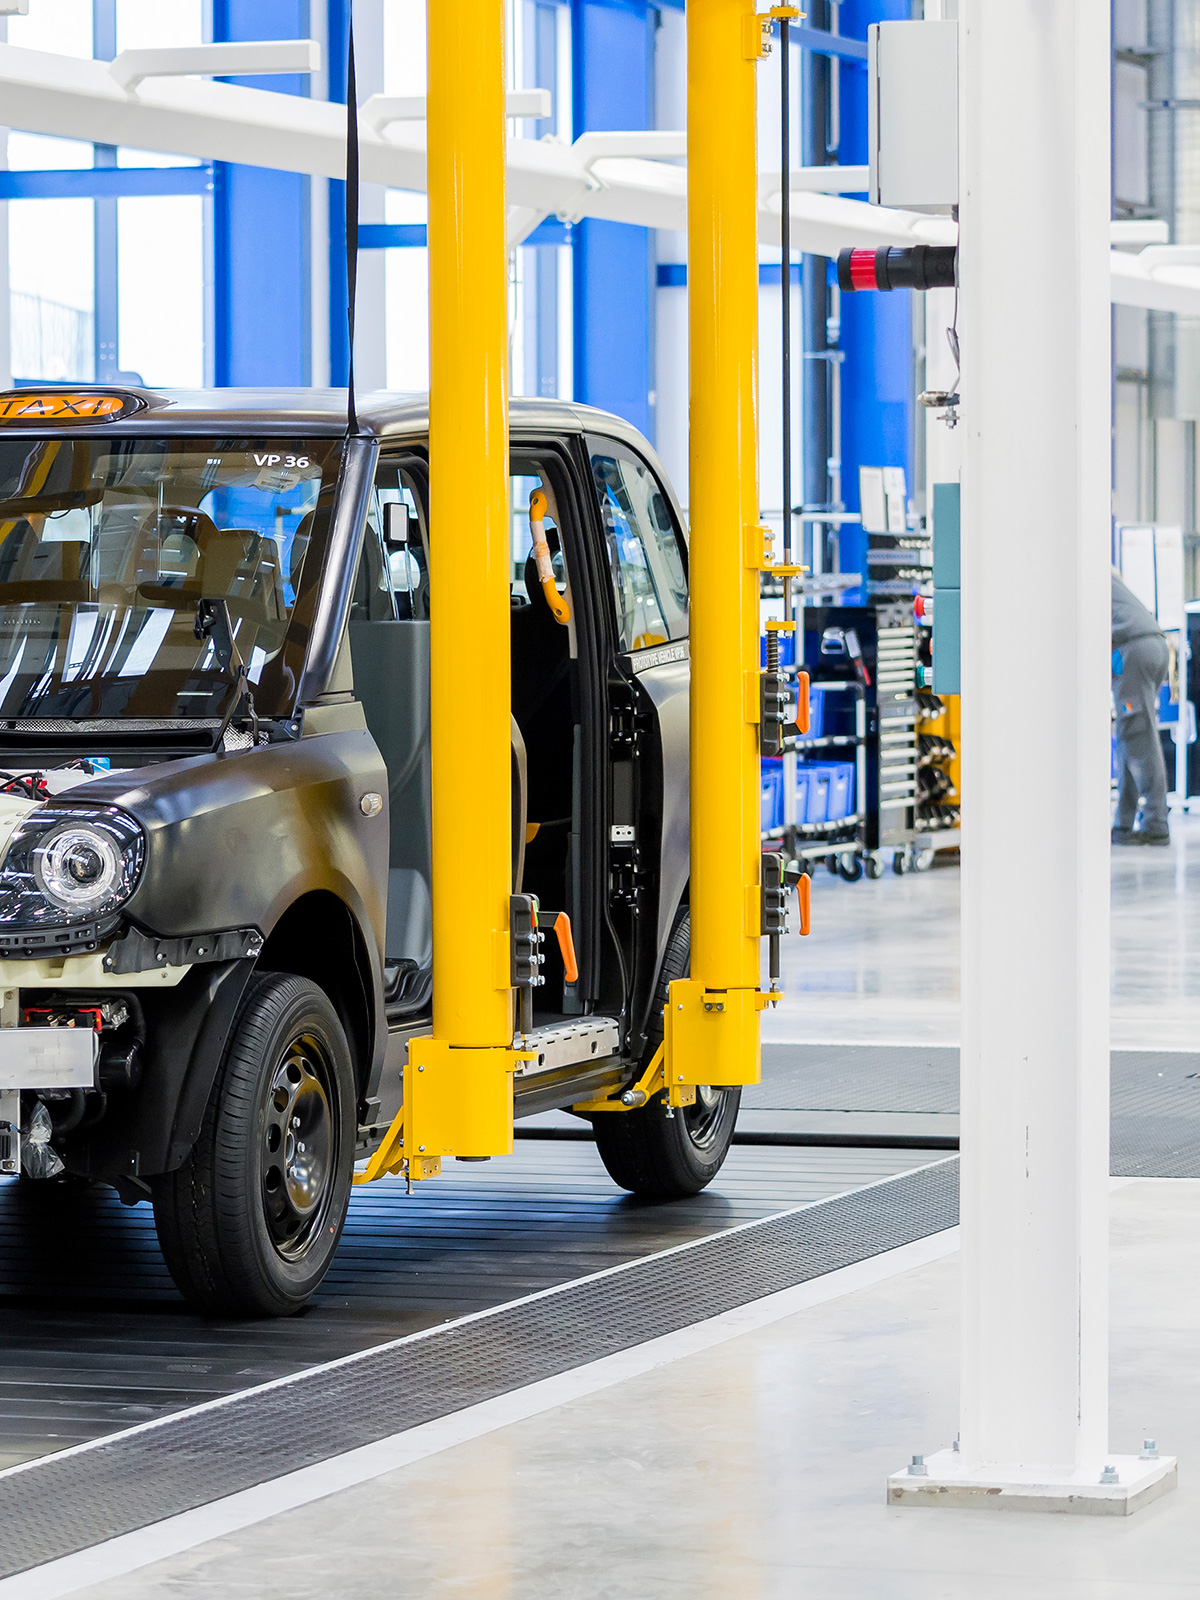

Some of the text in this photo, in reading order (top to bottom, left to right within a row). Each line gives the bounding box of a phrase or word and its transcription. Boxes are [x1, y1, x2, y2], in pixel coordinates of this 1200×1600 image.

[0, 399, 104, 416] TAXI
[253, 453, 310, 469] VP 36
